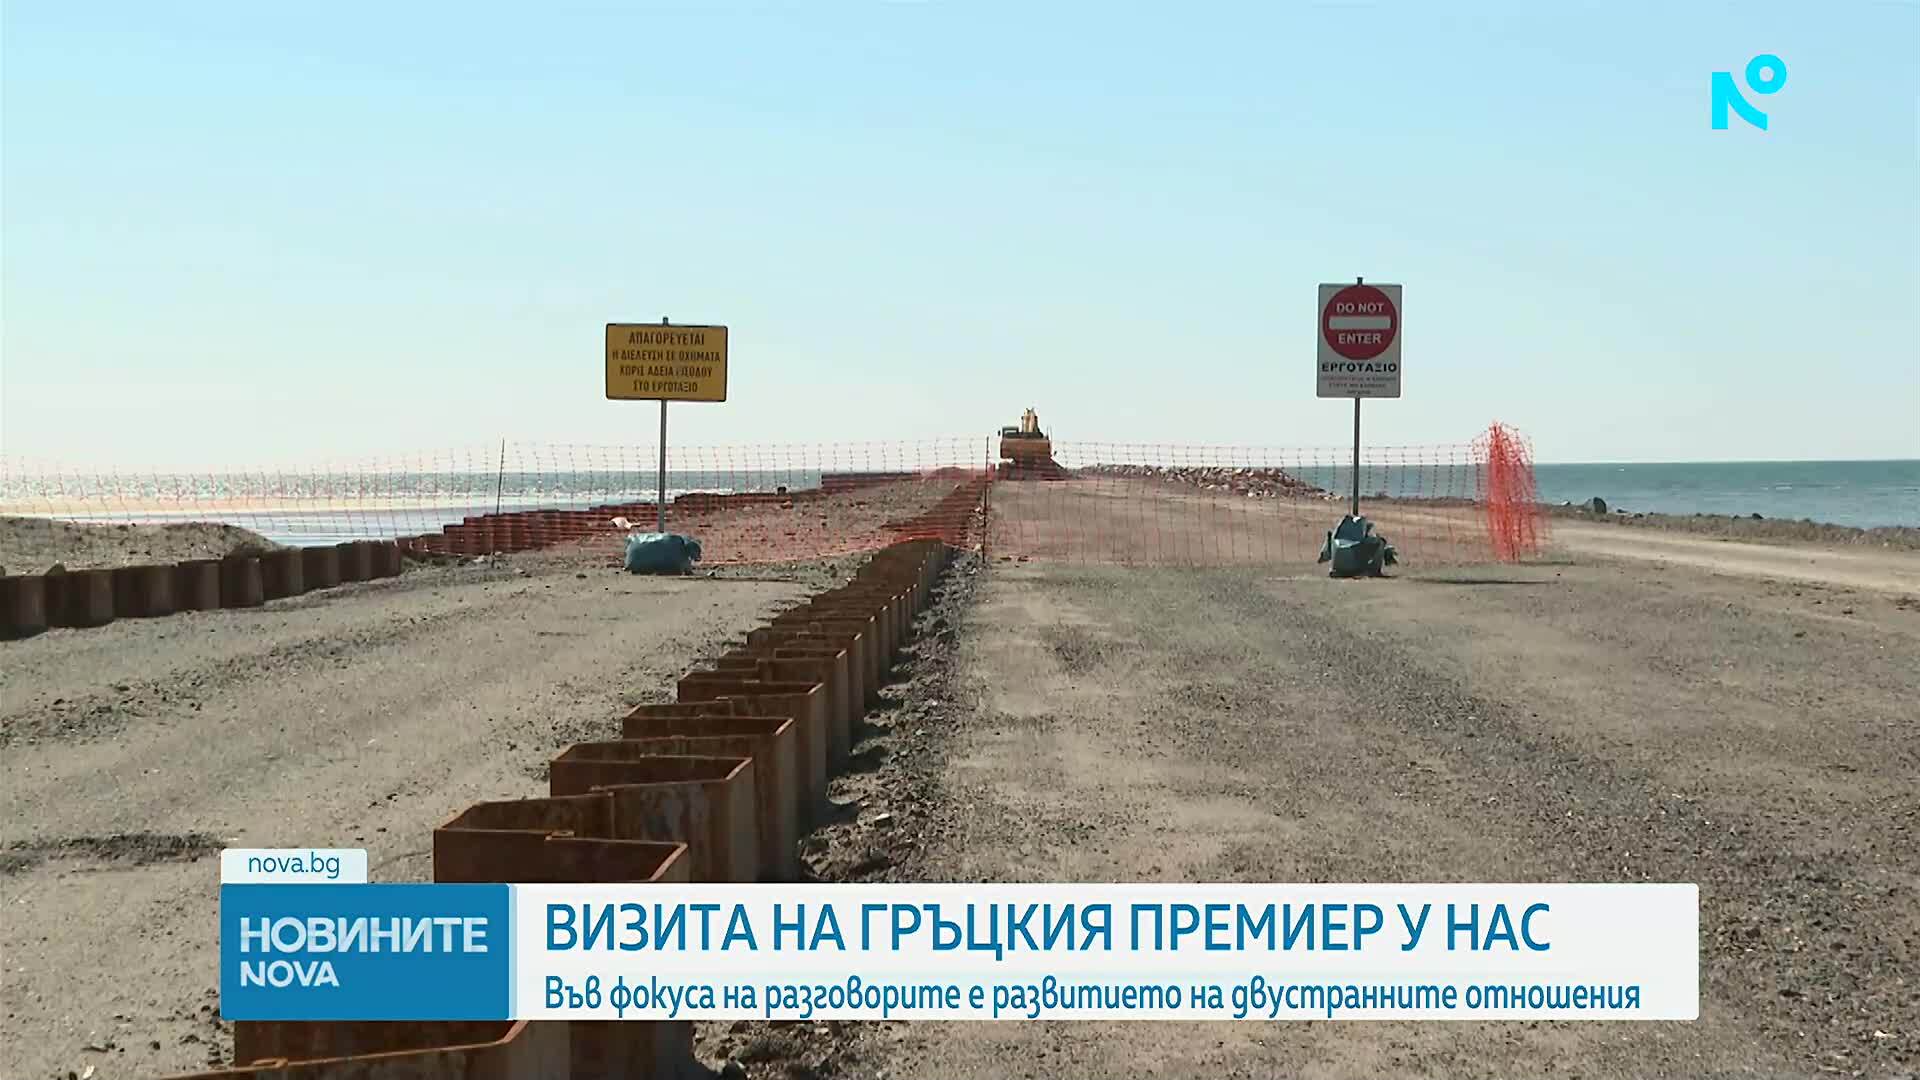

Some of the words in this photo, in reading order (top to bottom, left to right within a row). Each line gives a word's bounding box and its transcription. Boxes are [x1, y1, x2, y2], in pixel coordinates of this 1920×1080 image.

[1336, 303, 1355, 313] DO
[1358, 303, 1384, 313] NOT
[628, 332, 705, 345] ΑΠΑΓΟΡΕΥΕΤΑΙ
[1338, 333, 1382, 344] ENTER
[1321, 362, 1397, 373] ΕΡΓΟΤΑΞΙΟ
